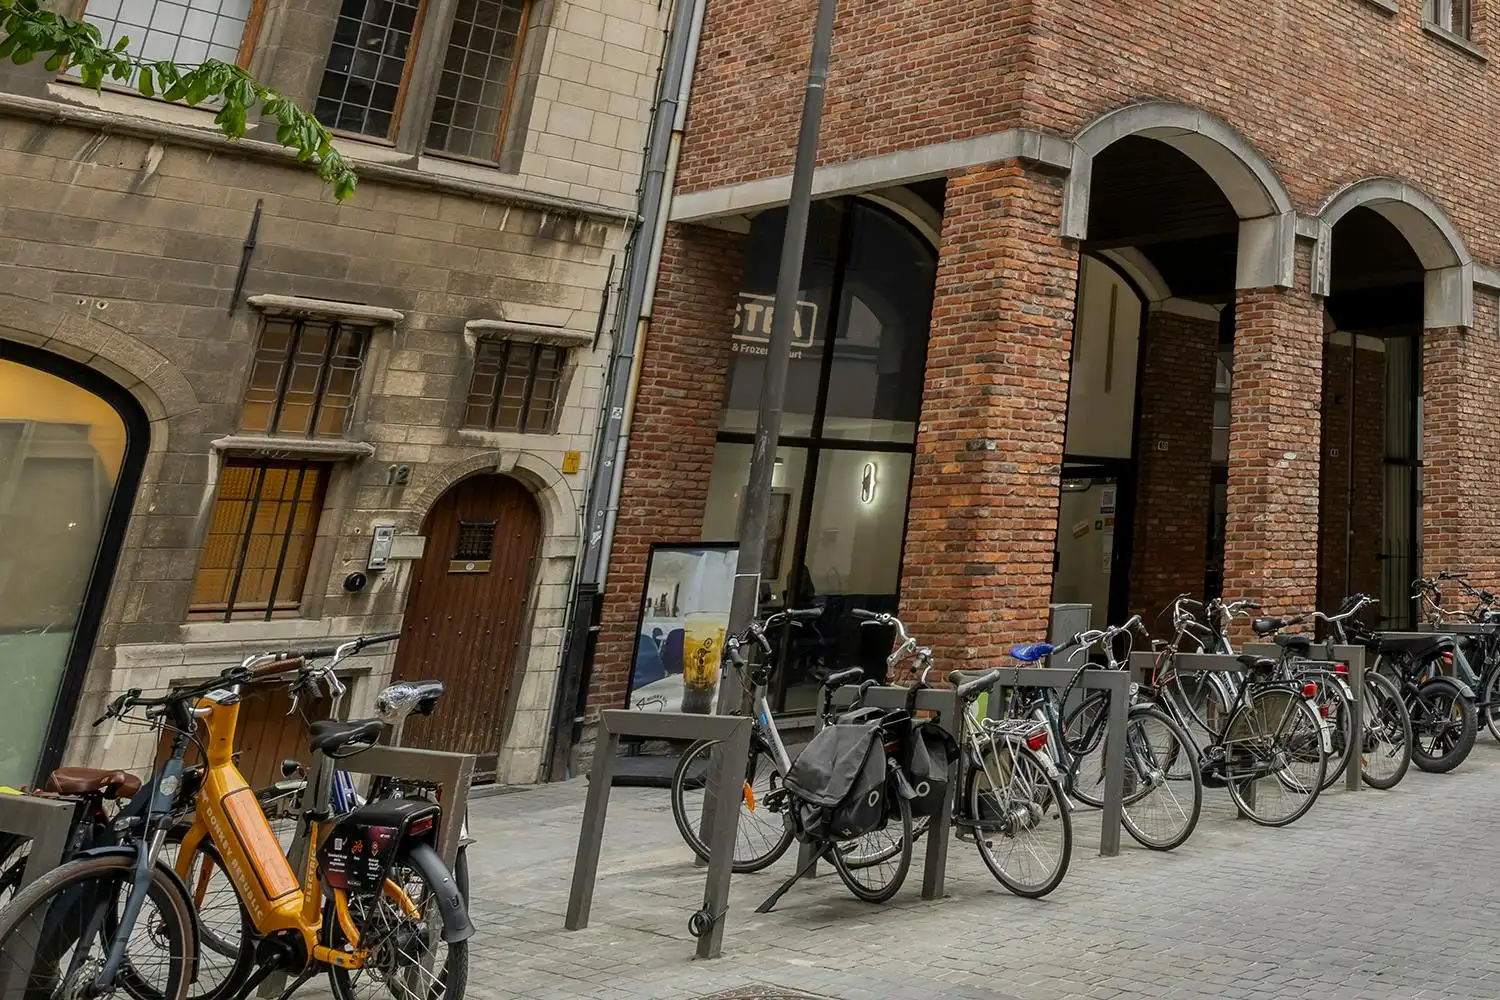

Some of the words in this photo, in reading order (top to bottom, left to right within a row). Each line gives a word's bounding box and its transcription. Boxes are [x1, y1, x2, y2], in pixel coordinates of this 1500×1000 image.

[388, 464, 409, 485] 12
[206, 807, 233, 857] DONKEY
[231, 859, 264, 920] REPUBLIC
[306, 850, 317, 903] ELECTRIC
